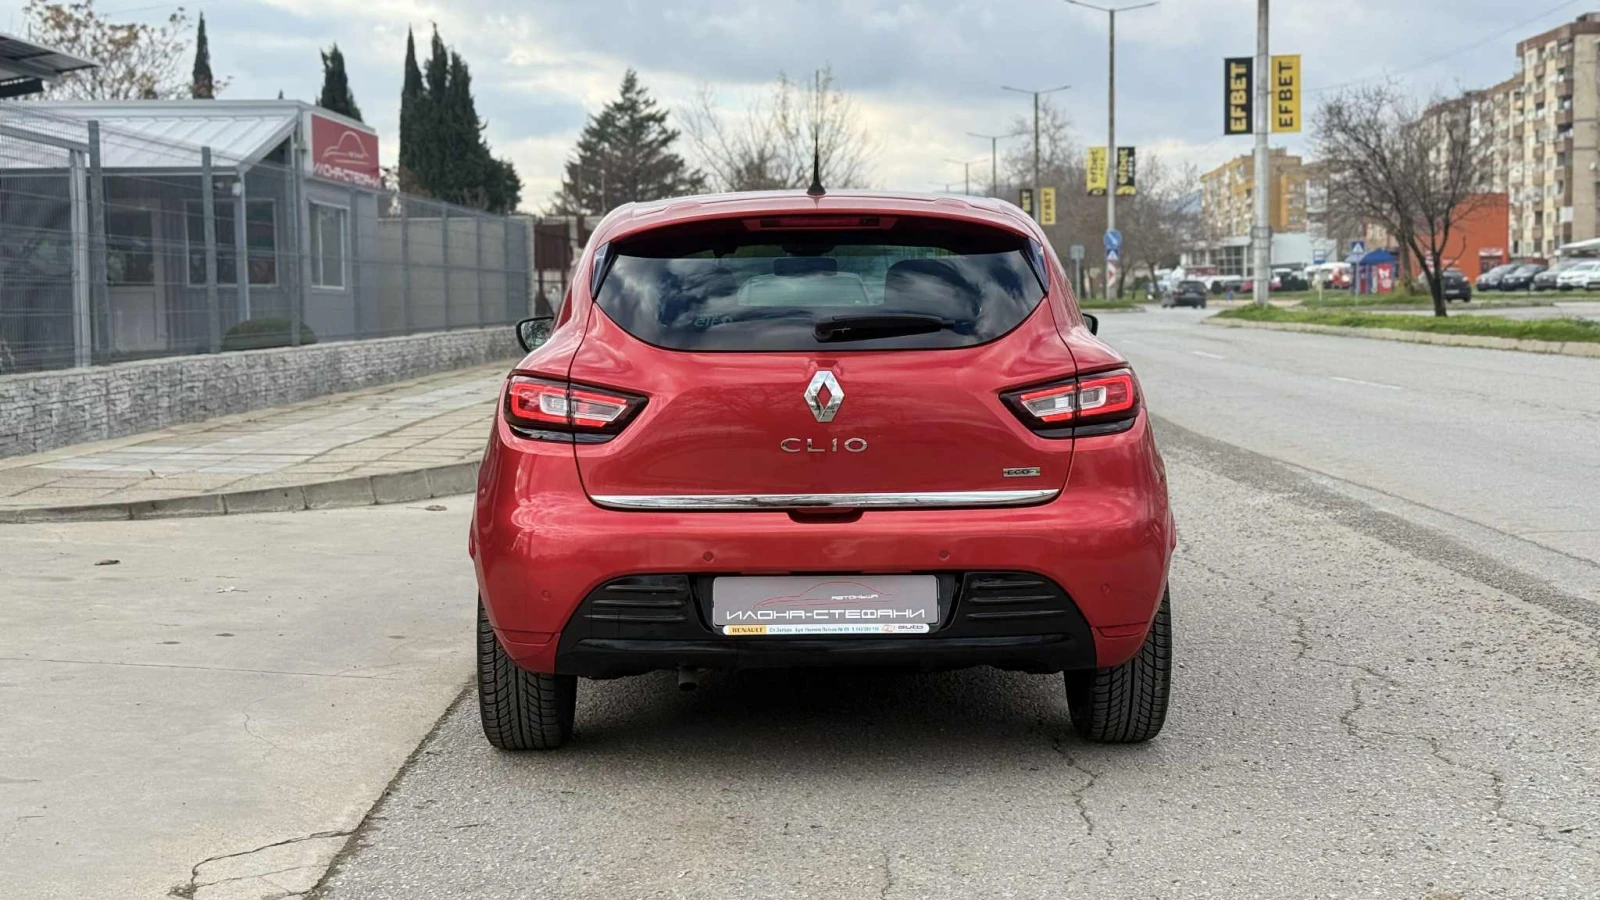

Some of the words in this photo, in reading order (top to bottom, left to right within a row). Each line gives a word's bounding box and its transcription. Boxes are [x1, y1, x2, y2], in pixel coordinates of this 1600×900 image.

[1230, 62, 1247, 132] EFBET
[1278, 61, 1293, 128] EFBET
[780, 437, 868, 453] CLIO
